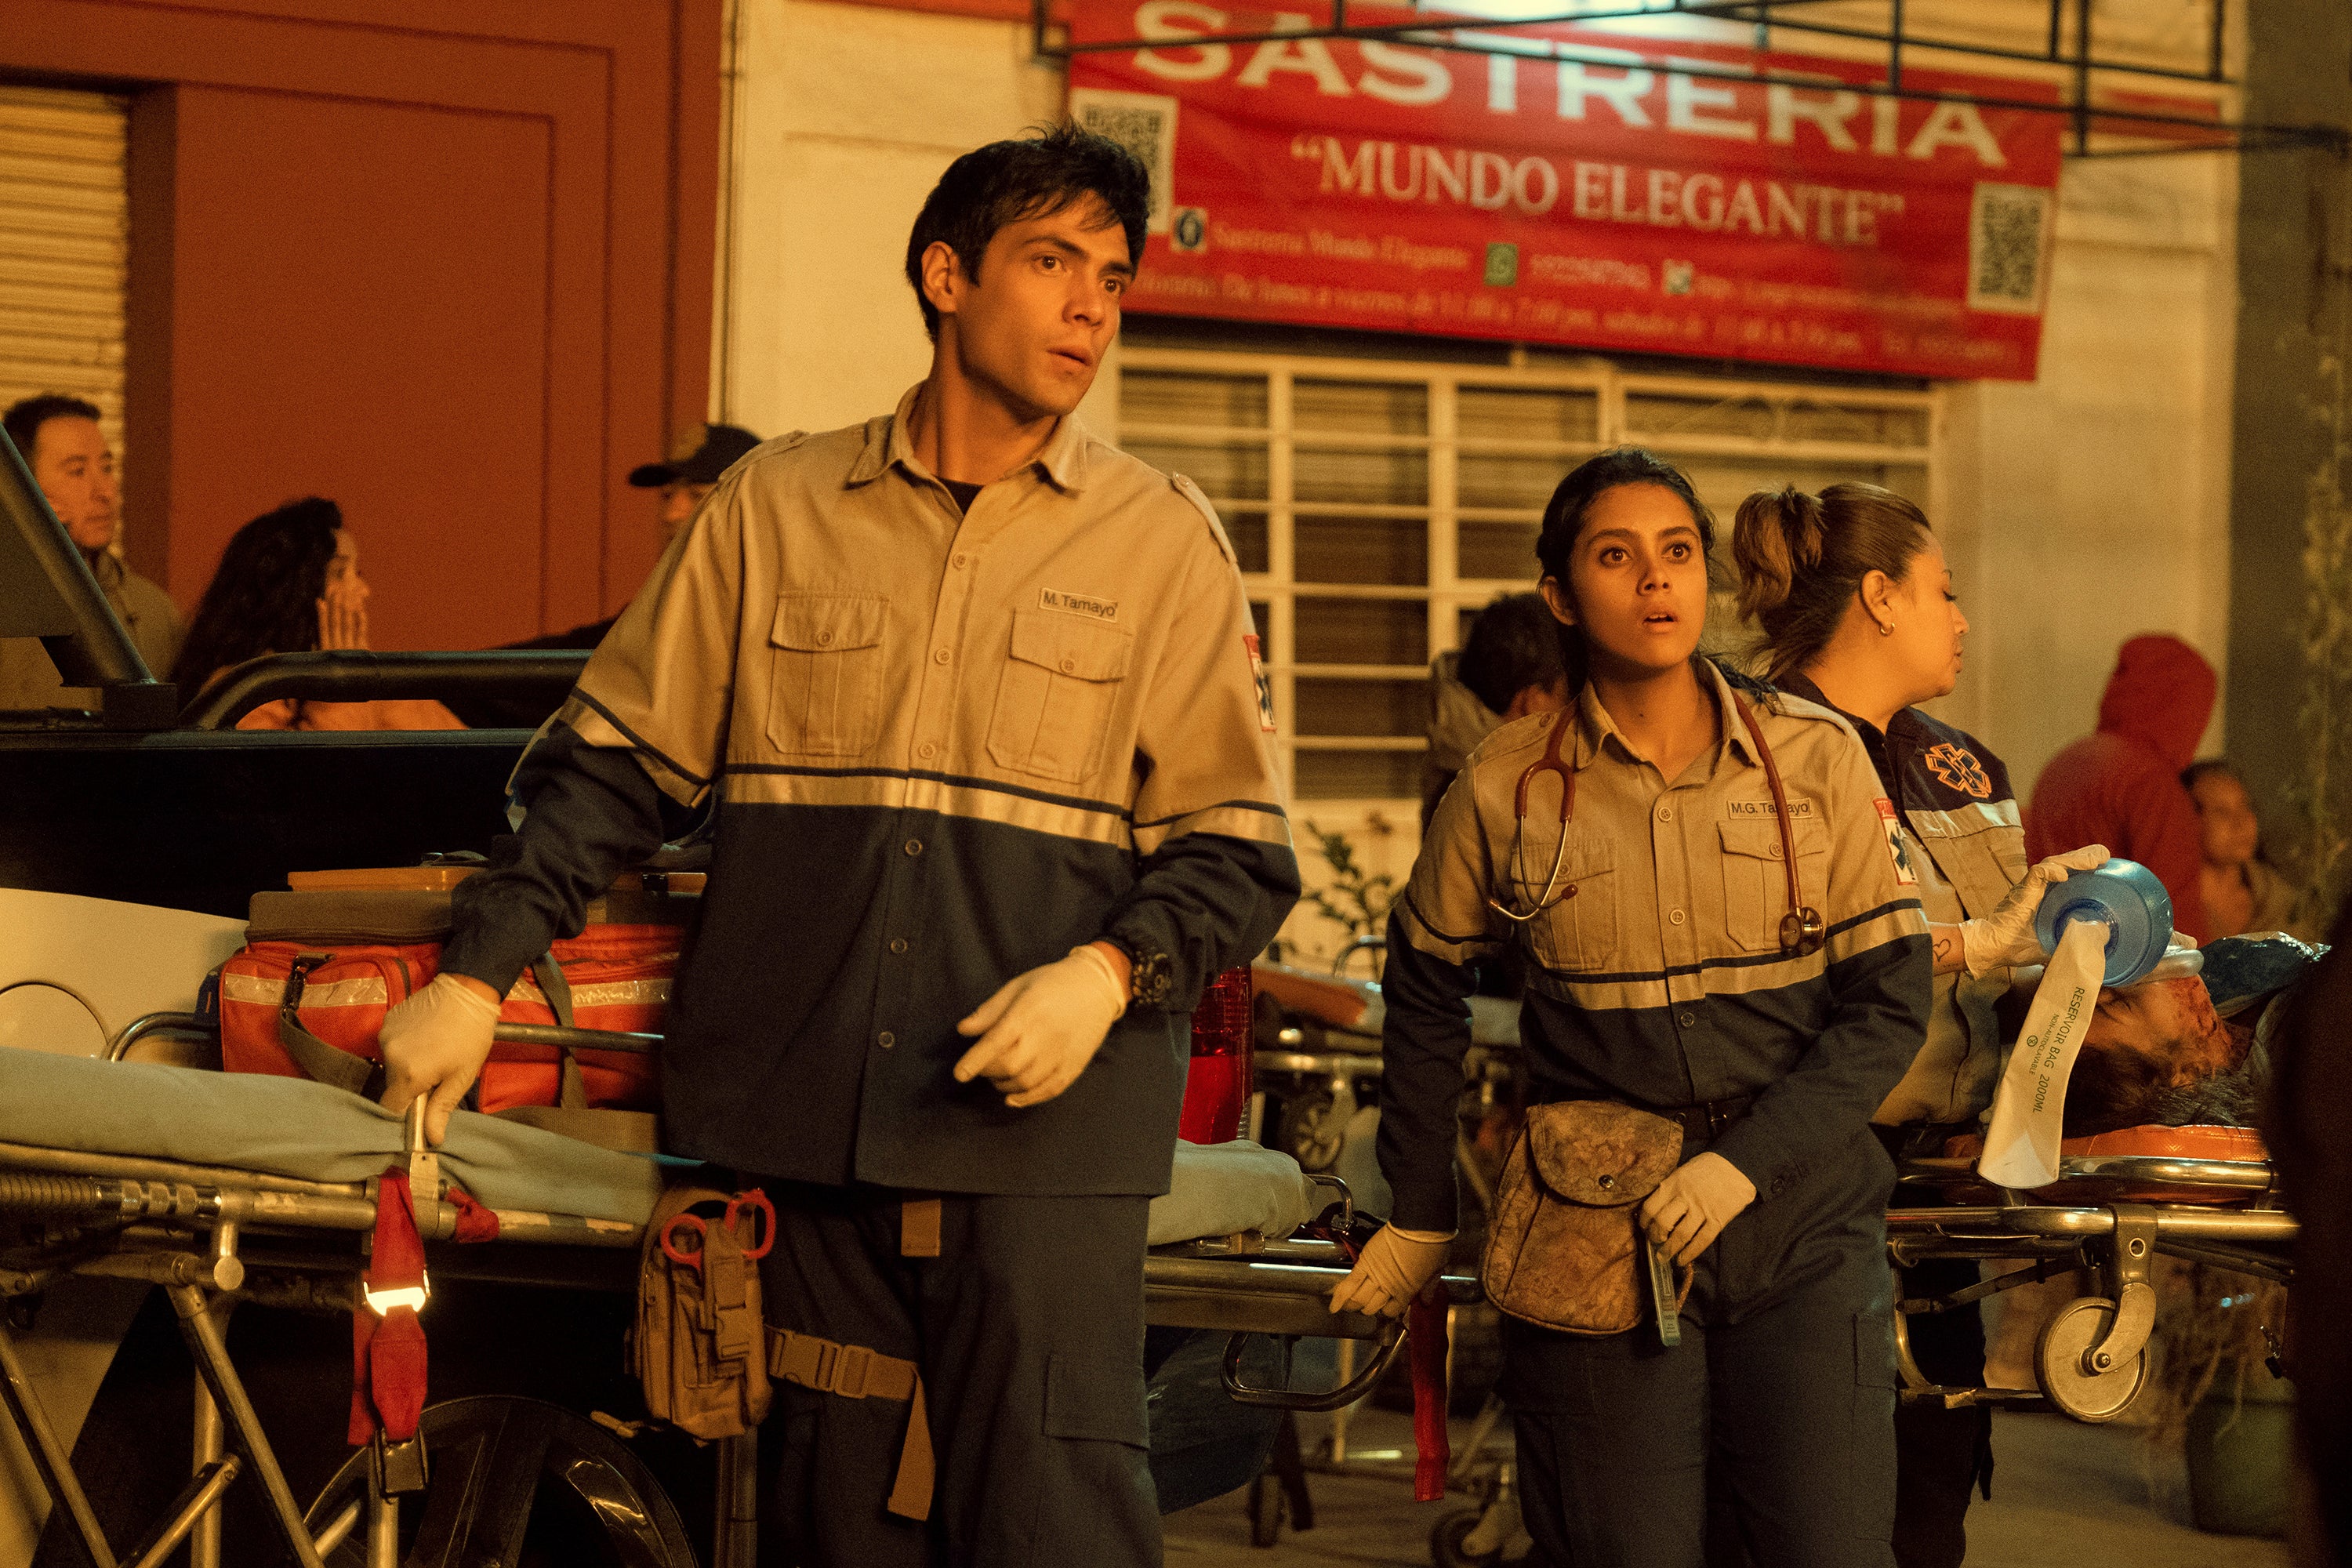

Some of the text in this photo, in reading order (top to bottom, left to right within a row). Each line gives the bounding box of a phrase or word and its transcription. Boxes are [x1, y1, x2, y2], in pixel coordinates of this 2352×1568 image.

[1133, 0, 2009, 168] SASTRERIA
[1044, 591, 1116, 617] M. Tamayo
[1731, 802, 1809, 815] M.G. Taayo
[2029, 1014, 2060, 1075] NON-AUTOCLAVABLE
[2032, 986, 2085, 1112] RESERVOIR BAG 2000ML
